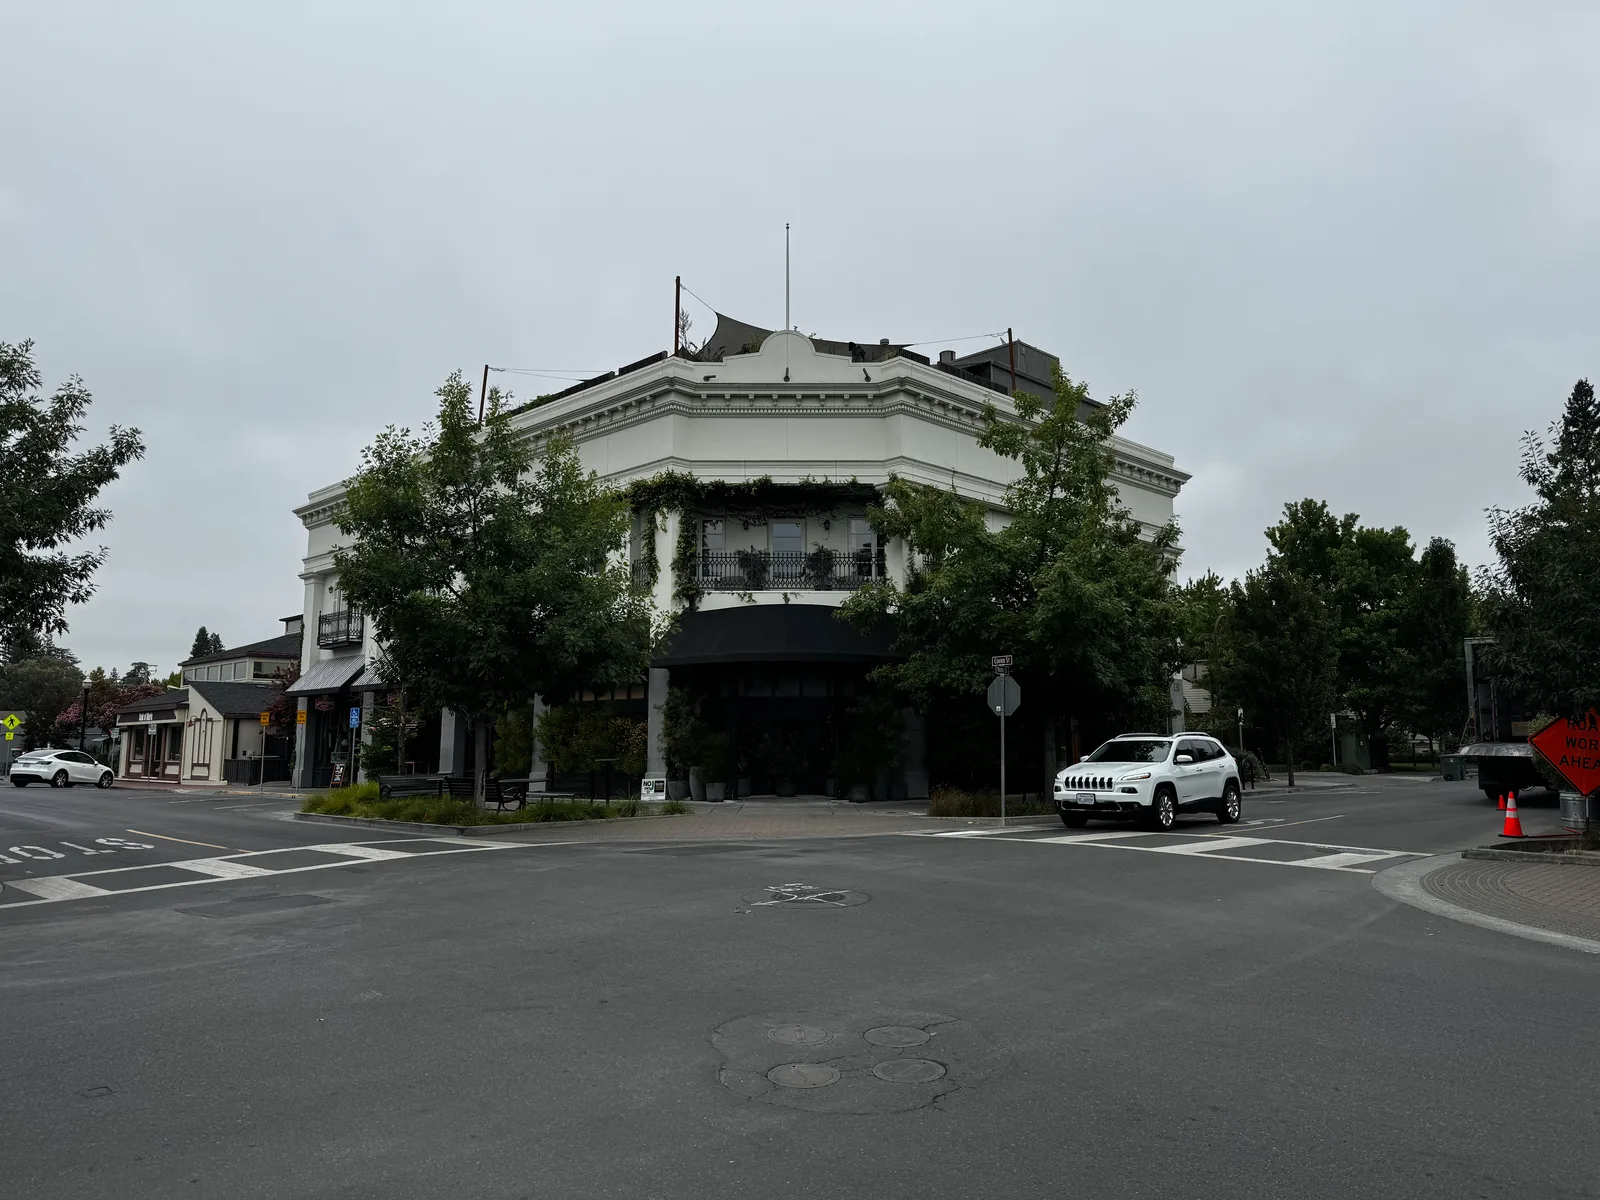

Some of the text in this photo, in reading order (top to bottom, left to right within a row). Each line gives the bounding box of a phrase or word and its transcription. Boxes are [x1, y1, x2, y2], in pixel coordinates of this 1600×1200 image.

[1567, 717, 1599, 732] ROA
[1566, 736, 1599, 751] WOR
[1559, 755, 1600, 769] AHEA
